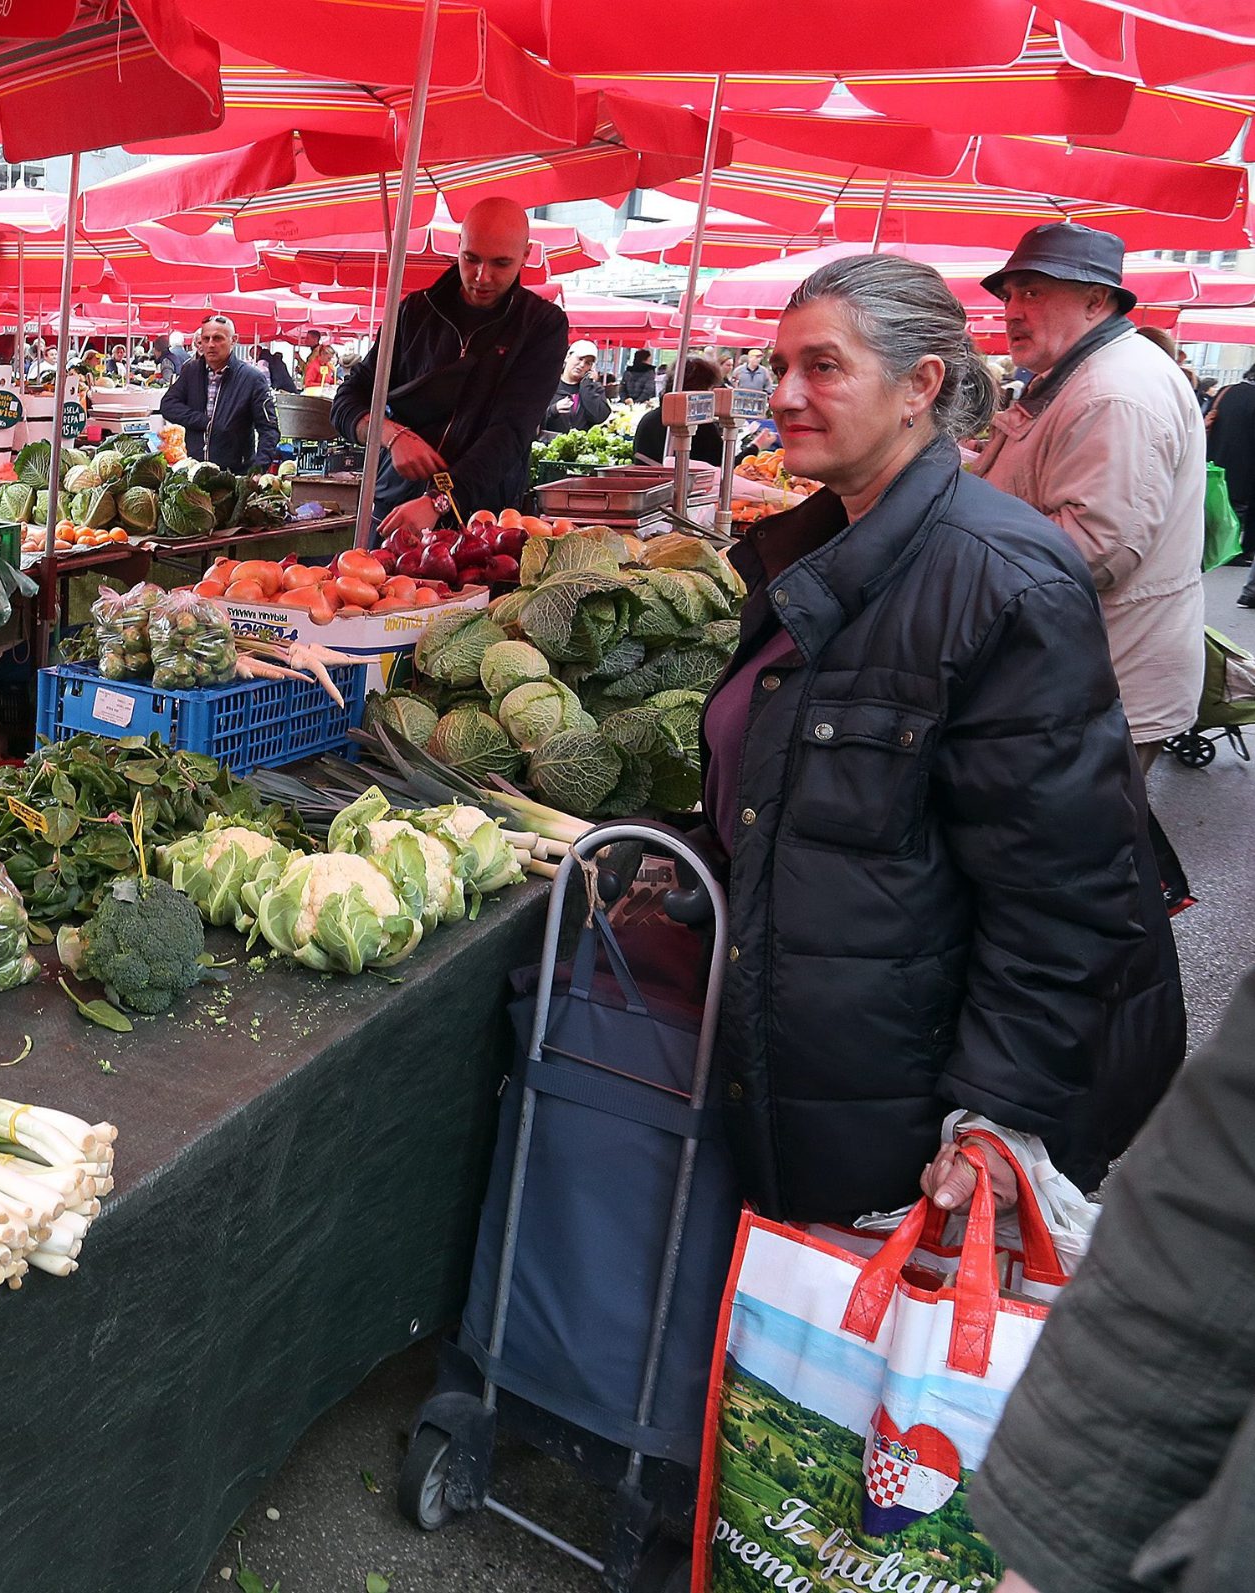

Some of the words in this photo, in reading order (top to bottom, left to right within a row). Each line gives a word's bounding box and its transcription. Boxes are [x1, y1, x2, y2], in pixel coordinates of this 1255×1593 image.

[63, 406, 80, 415] ISELA
[226, 607, 257, 619] BANANAS
[764, 1497, 816, 1547] Iz
